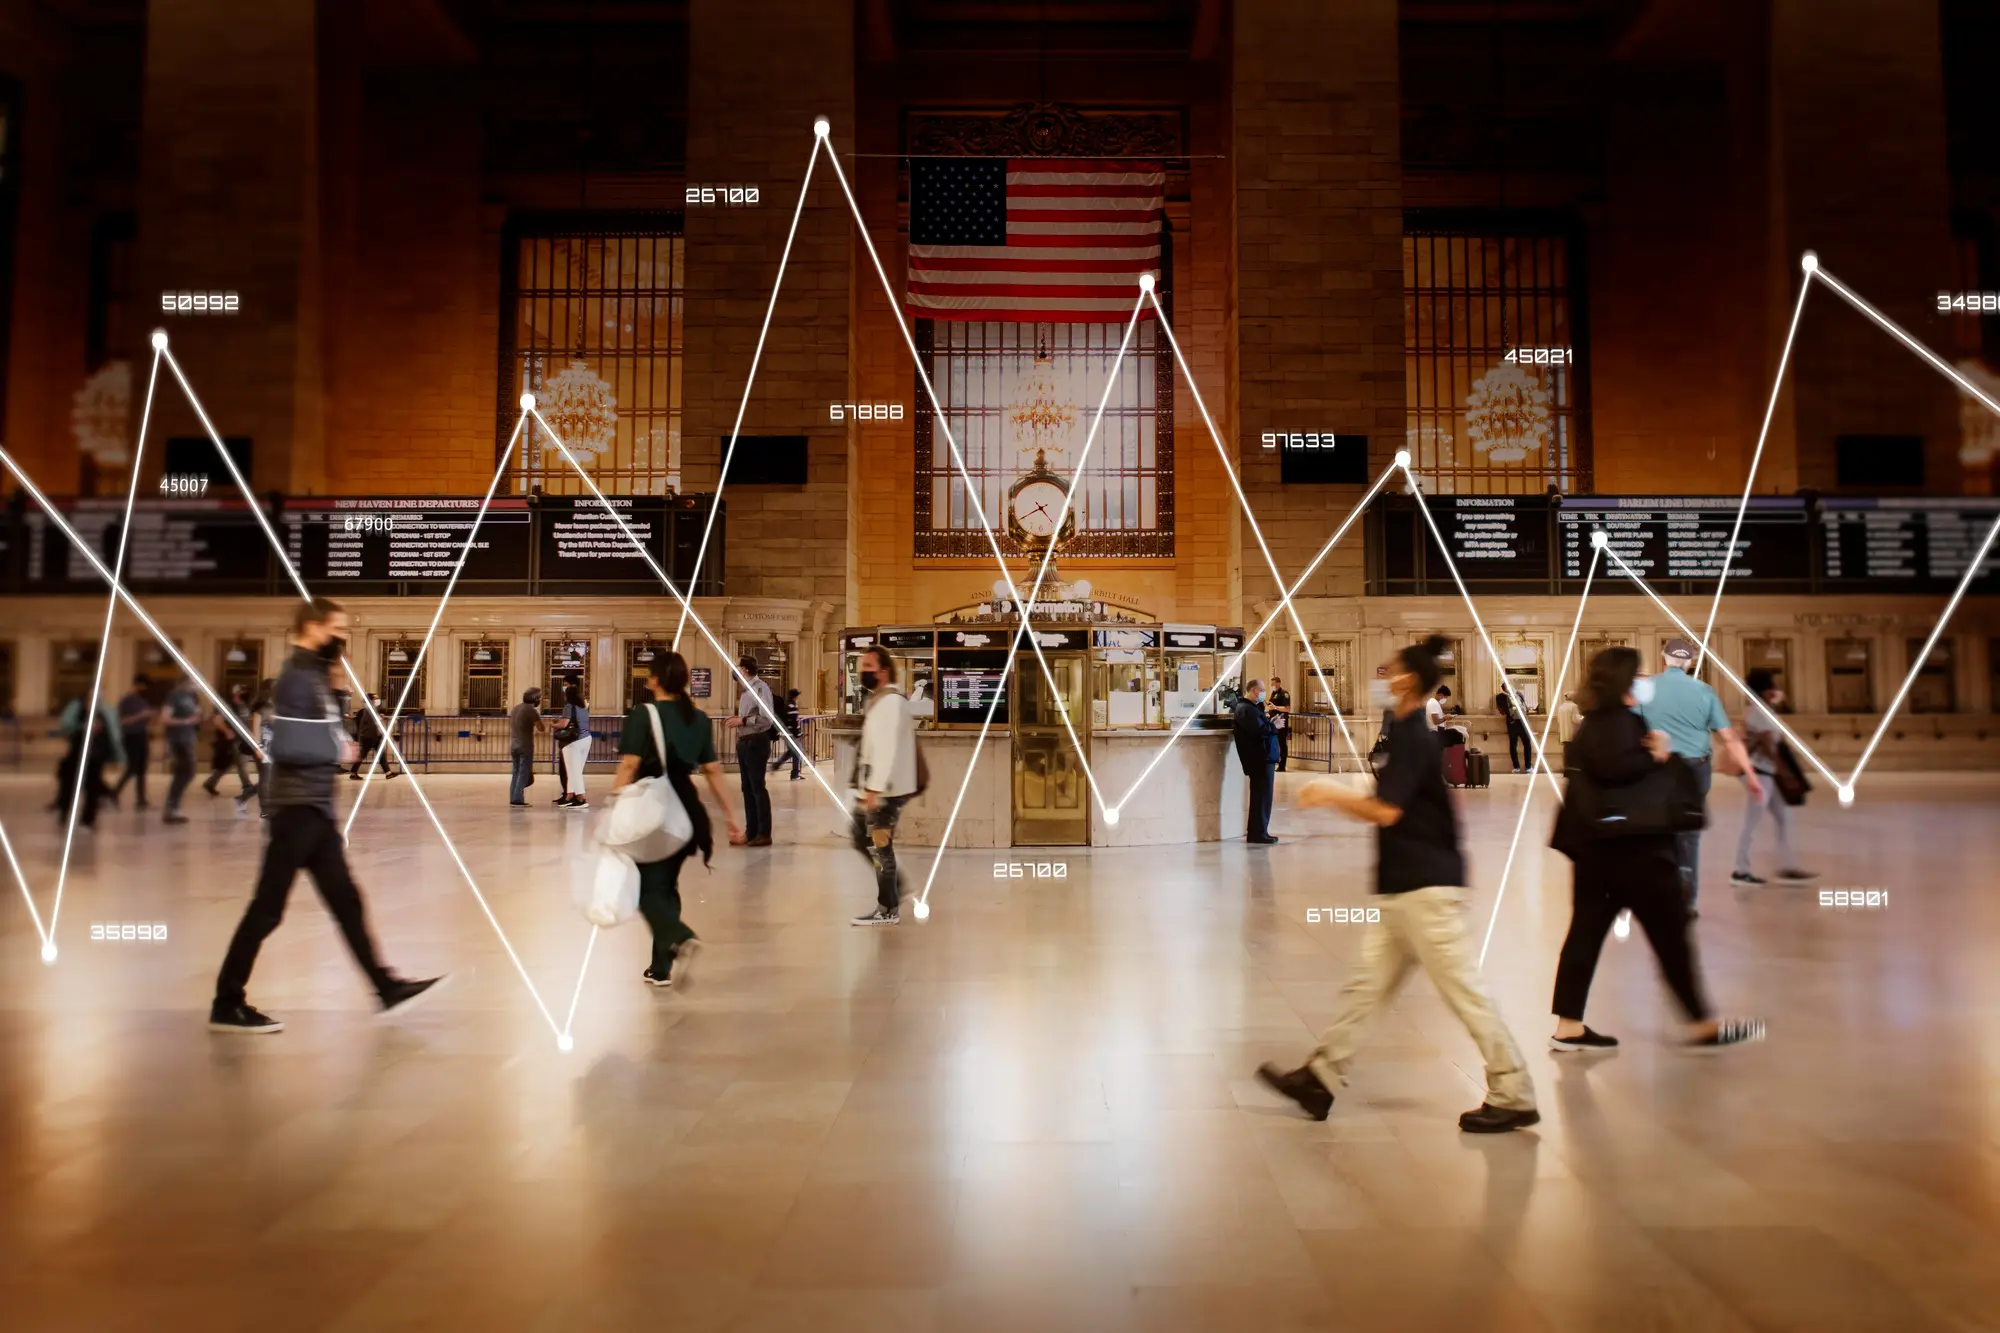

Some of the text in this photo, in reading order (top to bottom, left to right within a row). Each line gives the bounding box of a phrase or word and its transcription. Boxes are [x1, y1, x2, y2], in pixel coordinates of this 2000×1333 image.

[336, 499, 480, 508] NEW HAVEN LINE DEPARTURES
[1456, 498, 1515, 507] INFORMATION
